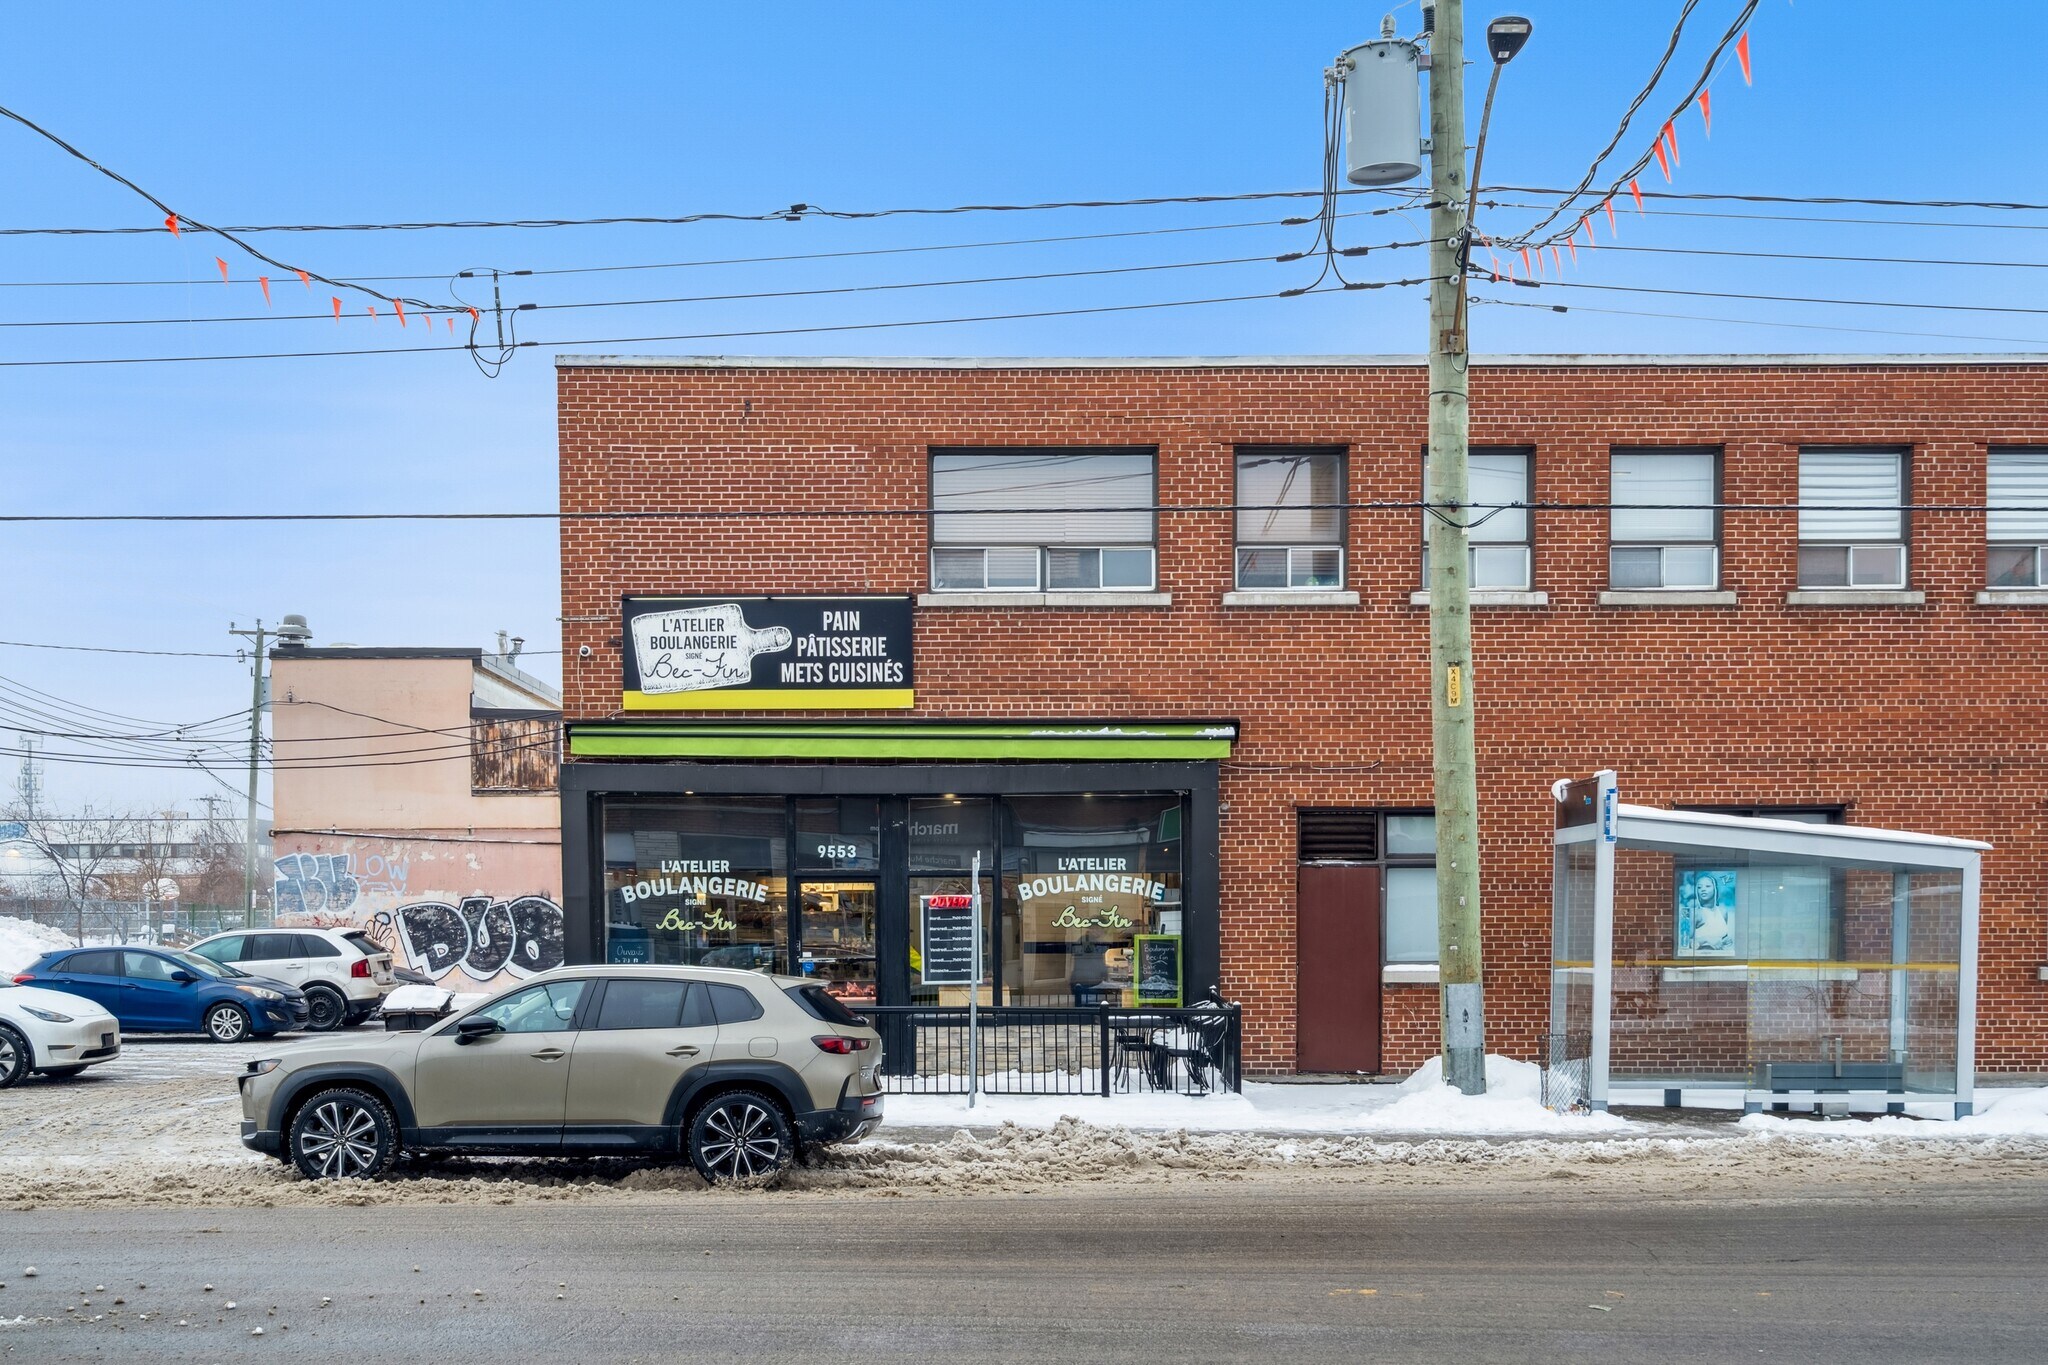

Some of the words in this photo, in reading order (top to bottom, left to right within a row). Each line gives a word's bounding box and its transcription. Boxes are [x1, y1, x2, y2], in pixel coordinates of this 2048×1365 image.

[662, 618, 725, 633] L'ATELIER
[822, 611, 861, 631] PAIN
[650, 635, 738, 651] BOULANGERIE
[796, 633, 888, 658] PÂTISSERIE
[644, 652, 744, 679] Bec-Fin
[780, 662, 824, 683] METS
[828, 659, 904, 683] CUISINÉS
[817, 845, 857, 858] 9553
[661, 860, 730, 873] L'ATELIER
[1057, 857, 1127, 871] L'ATELIER
[621, 876, 769, 903] BOULANGERIE
[1018, 874, 1166, 901] BOULANGERIE
[929, 896, 971, 907] OUVERT
[1081, 895, 1103, 903] SIGNÉ
[656, 908, 737, 931] Bec-Fin
[1051, 905, 1133, 928] Bec-Fin
